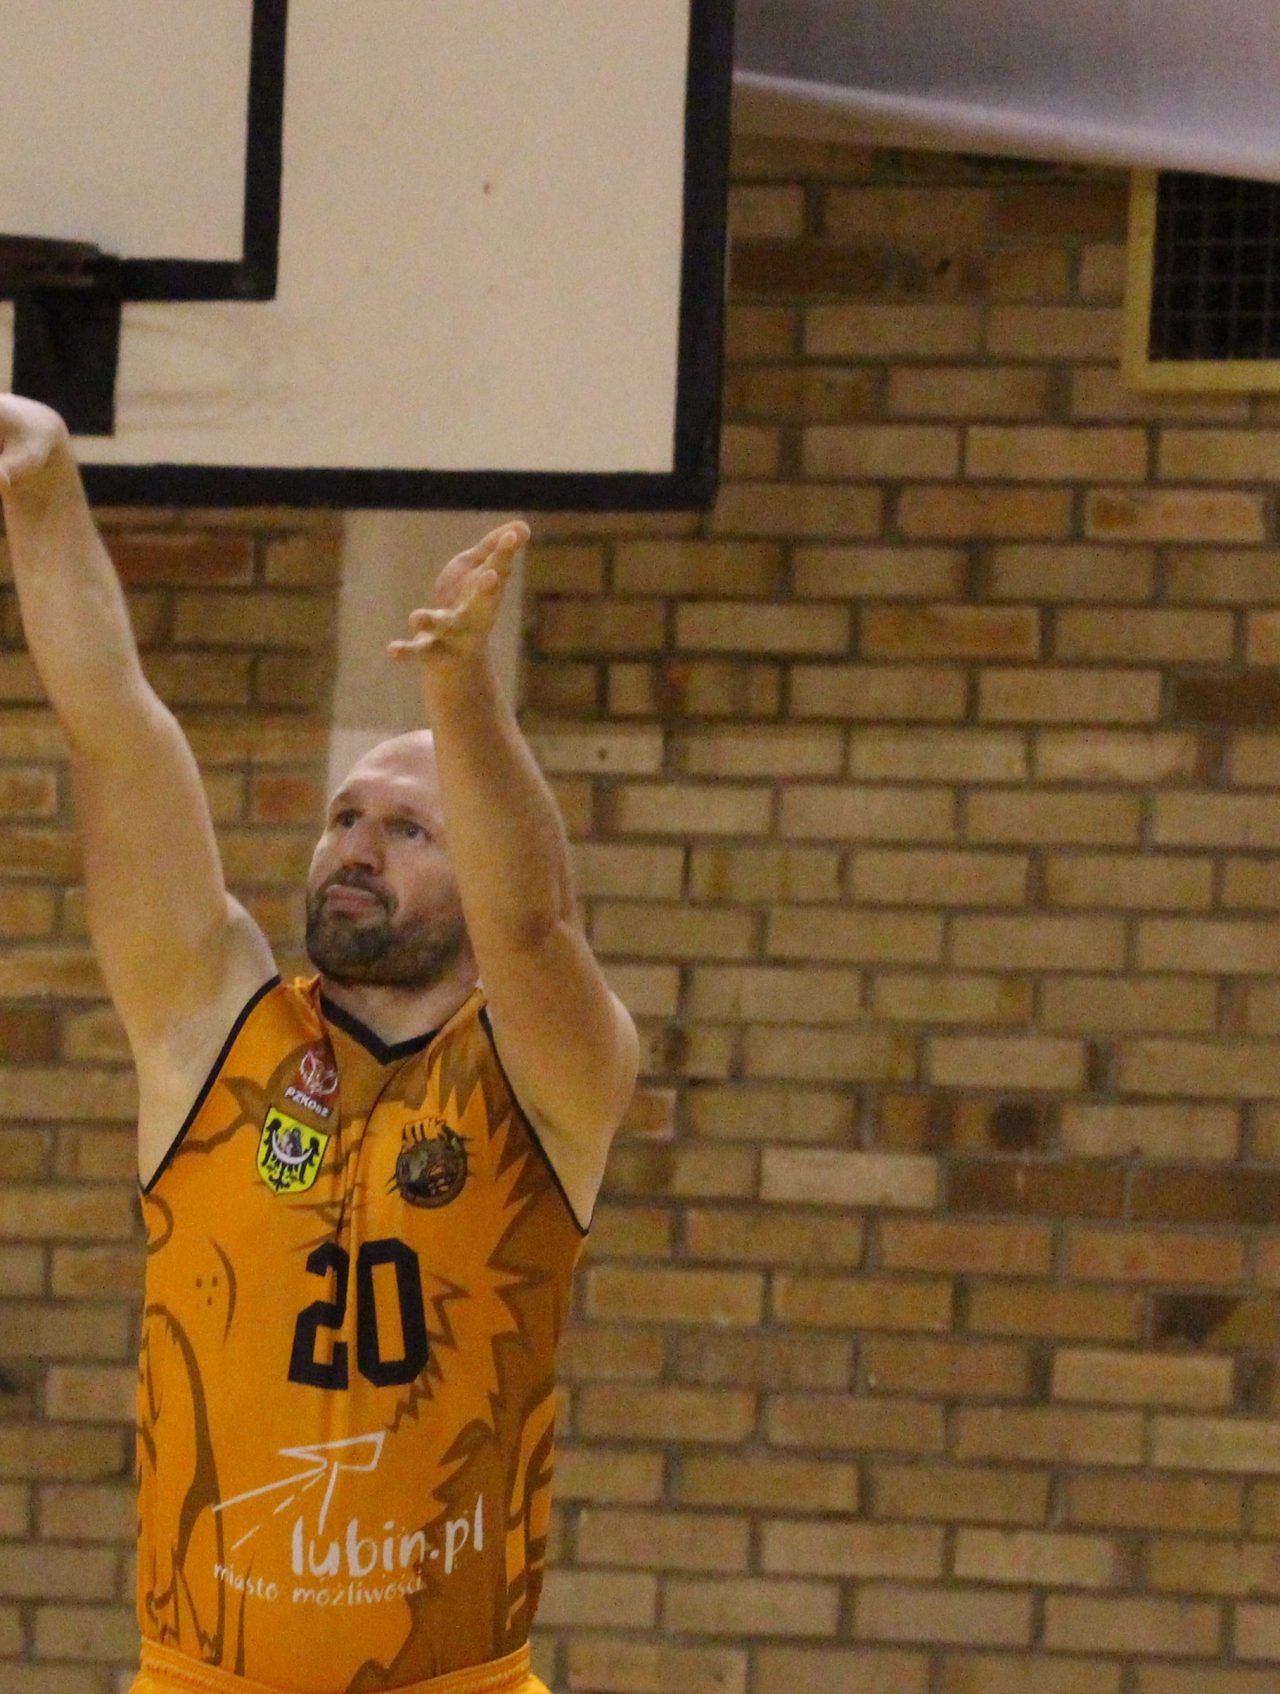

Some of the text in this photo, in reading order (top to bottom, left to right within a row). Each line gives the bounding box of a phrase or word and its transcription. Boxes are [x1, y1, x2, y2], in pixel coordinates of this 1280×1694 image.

[288, 1238, 428, 1390] 20
[292, 1493, 484, 1577] lubin.pl
[214, 1563, 278, 1601] miasto
